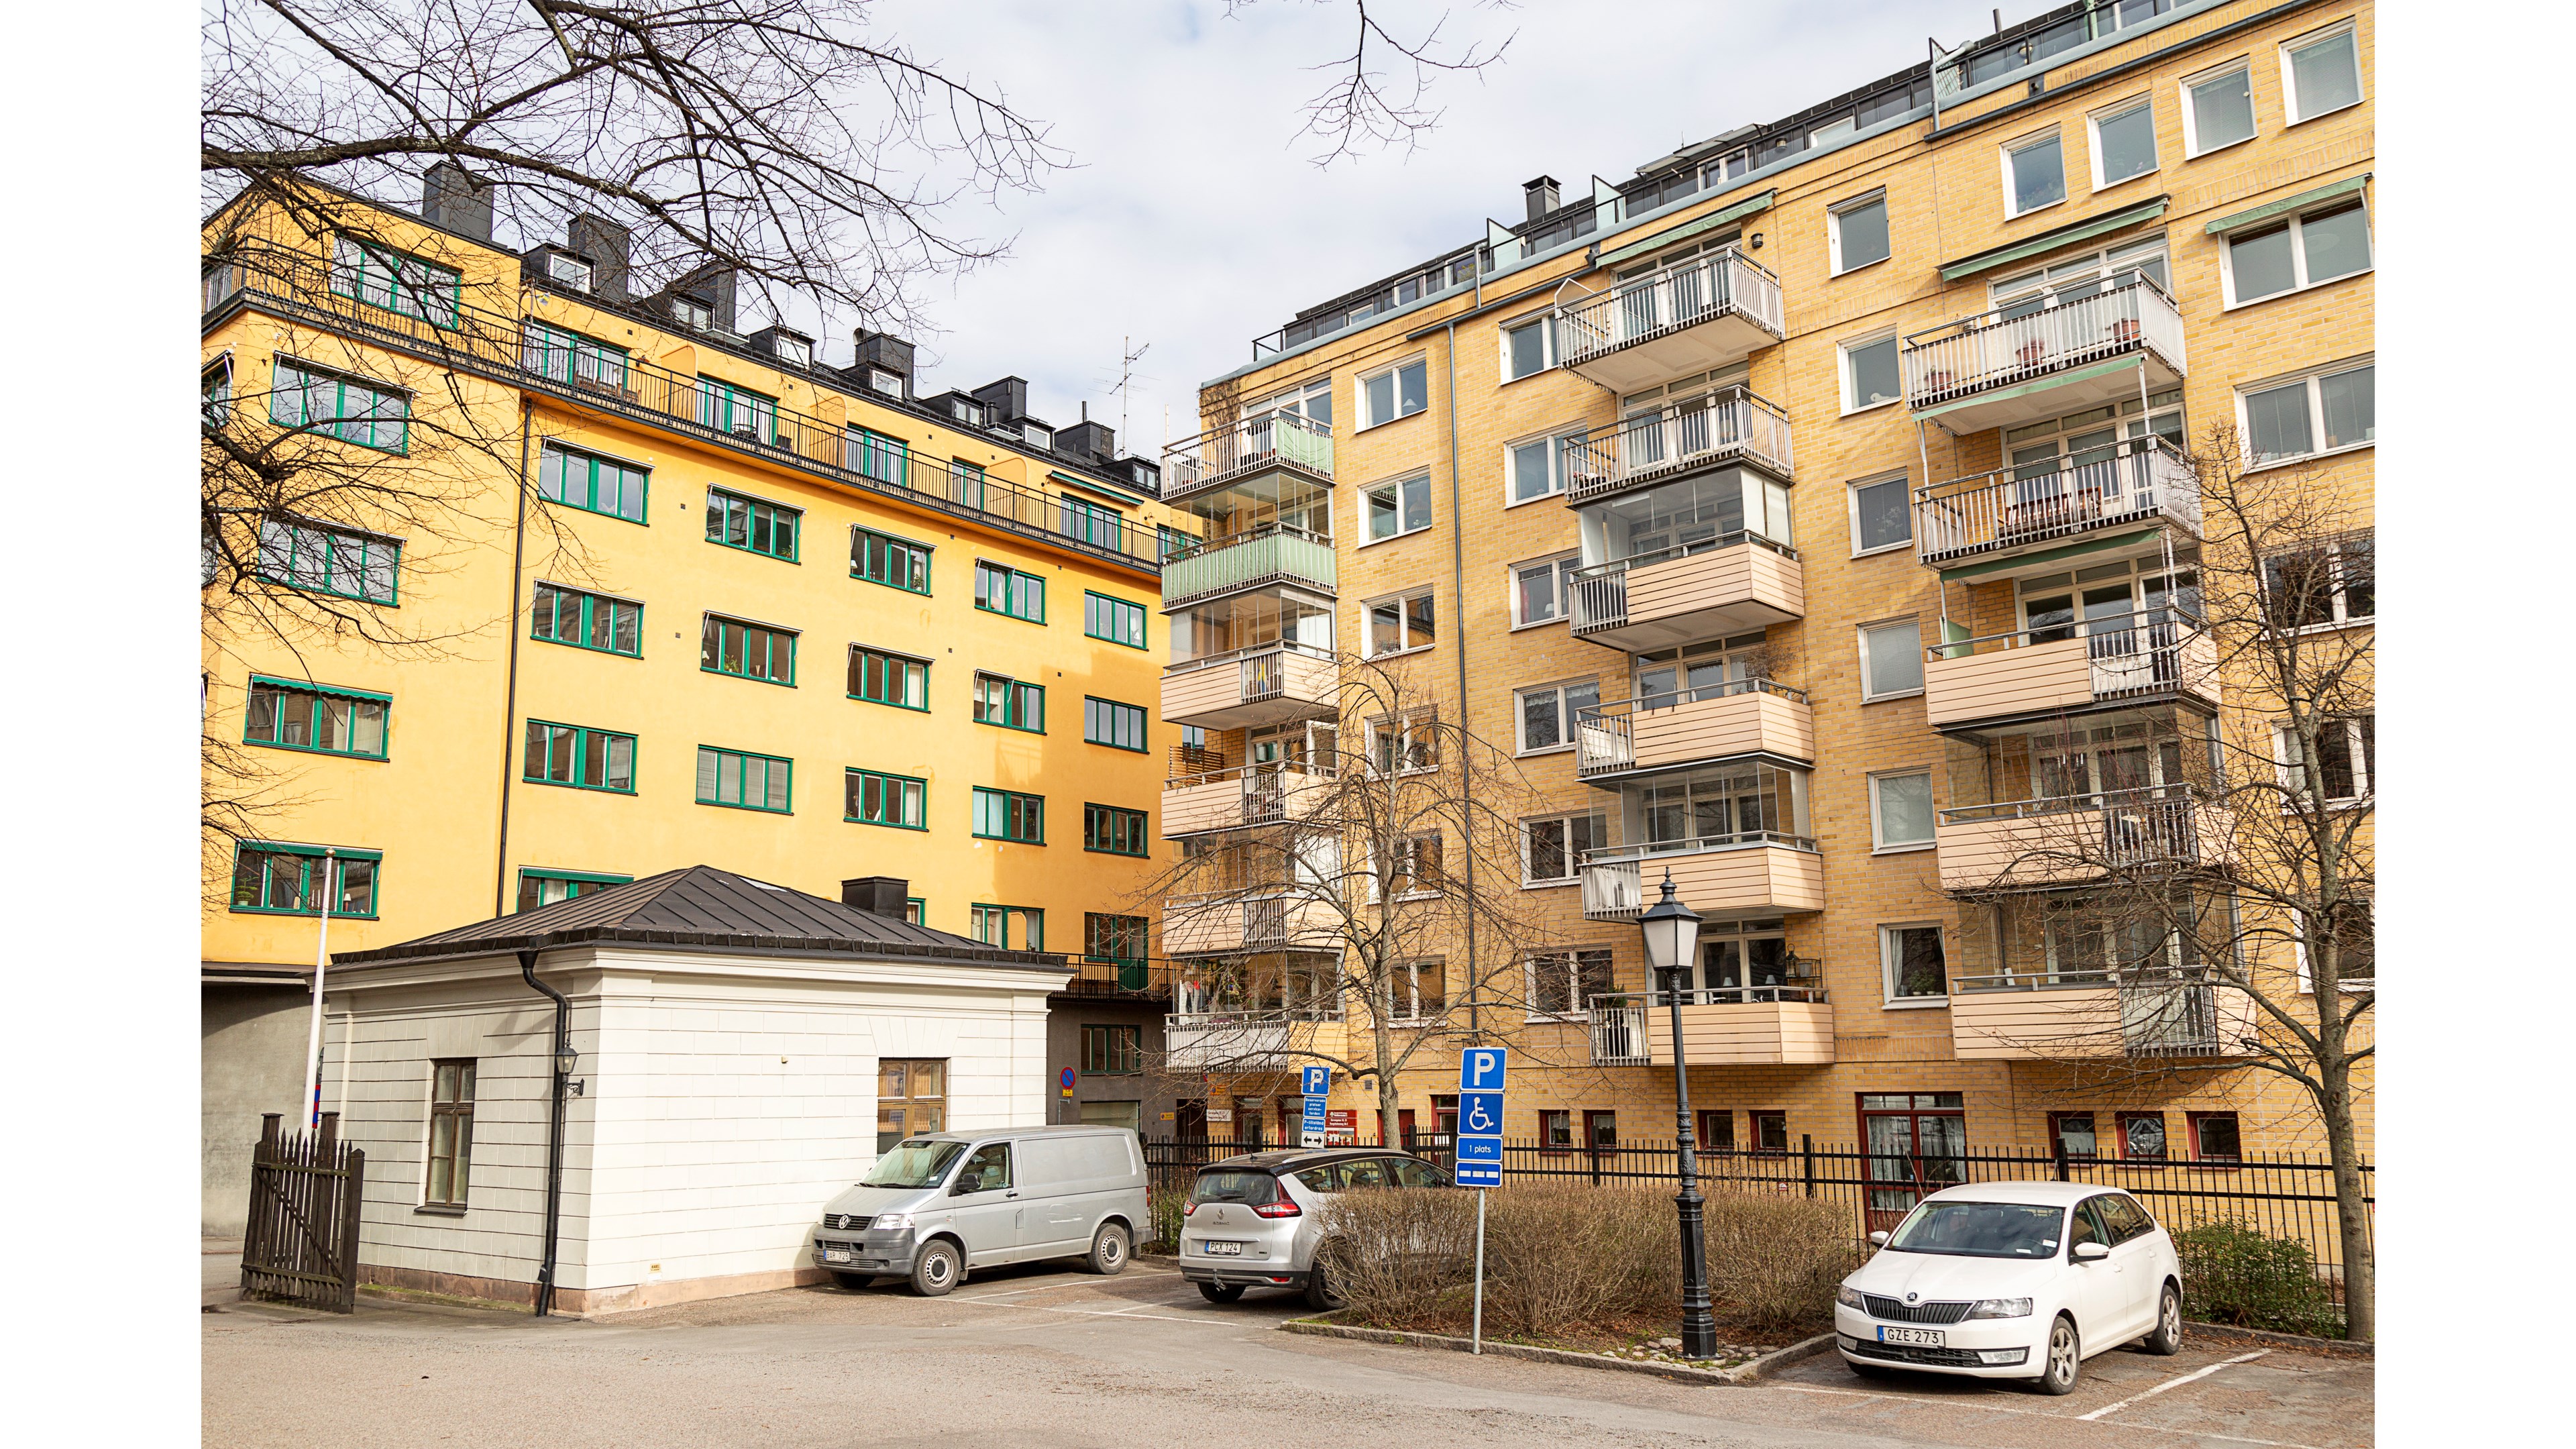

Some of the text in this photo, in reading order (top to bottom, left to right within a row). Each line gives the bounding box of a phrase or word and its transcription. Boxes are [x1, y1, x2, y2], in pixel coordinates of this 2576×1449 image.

[1473, 1052, 1495, 1086] P
[1310, 1069, 1324, 1092] P
[1470, 1144, 1491, 1154] 1 plats
[1210, 1242, 1238, 1252] PCX 124
[839, 1252, 849, 1260] 725
[1888, 1328, 1939, 1344] GZE 273
